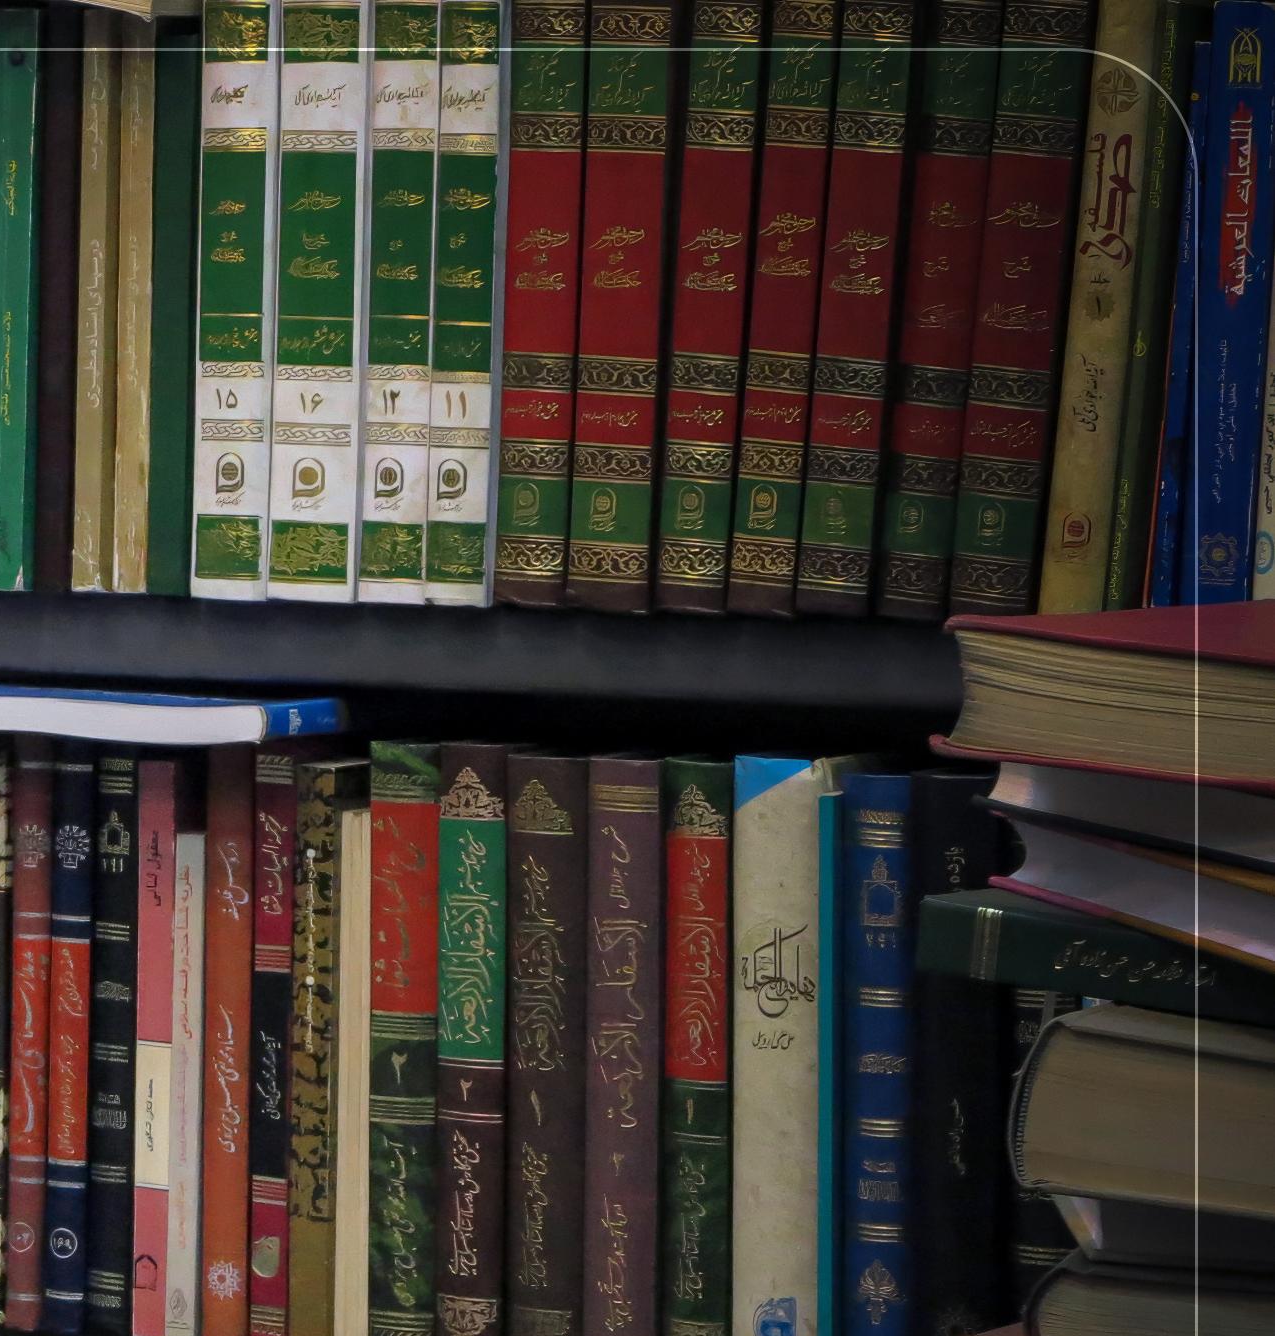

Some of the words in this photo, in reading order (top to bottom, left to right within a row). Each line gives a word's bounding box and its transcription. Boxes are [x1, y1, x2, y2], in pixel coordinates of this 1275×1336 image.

[1228, 115, 1253, 203] اللمعات
[1084, 133, 1108, 232] فلسفه
[215, 388, 238, 410] ۱۵
[300, 392, 324, 414] ۱۶
[445, 389, 467, 418] ۱۱
